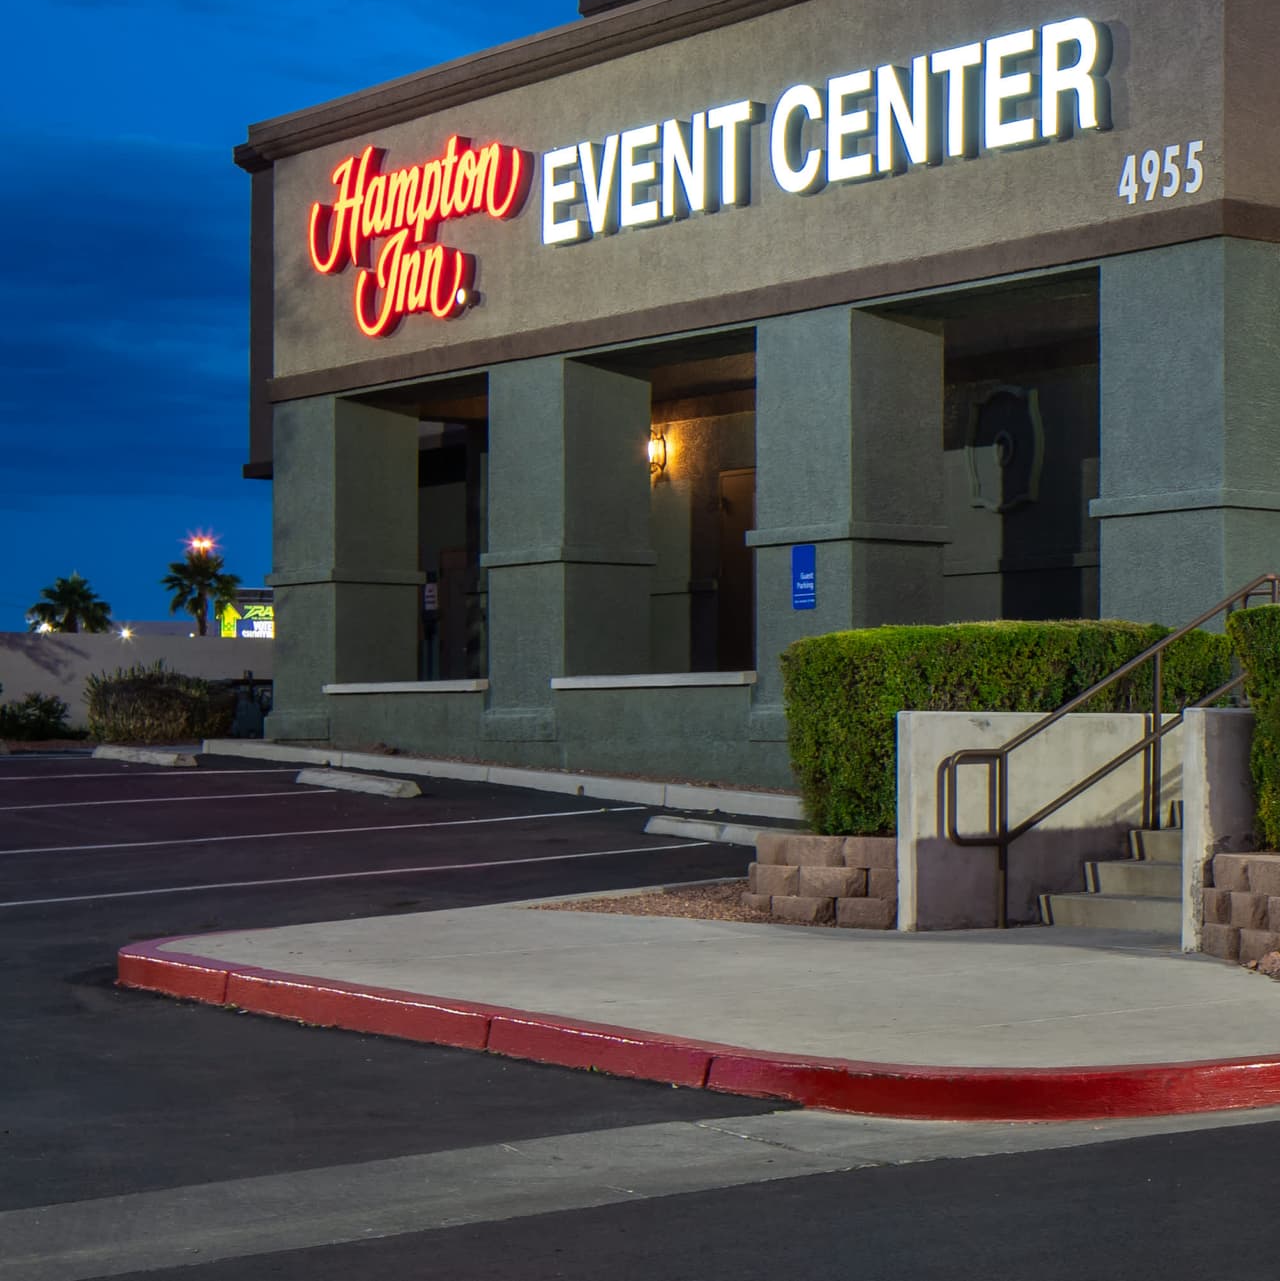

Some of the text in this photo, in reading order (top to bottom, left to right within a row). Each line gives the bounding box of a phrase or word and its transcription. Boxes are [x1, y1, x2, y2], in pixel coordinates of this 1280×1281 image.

[542, 16, 1098, 246] EVENT CENTER
[1117, 139, 1203, 205] 4955
[308, 134, 521, 274] Hampton
